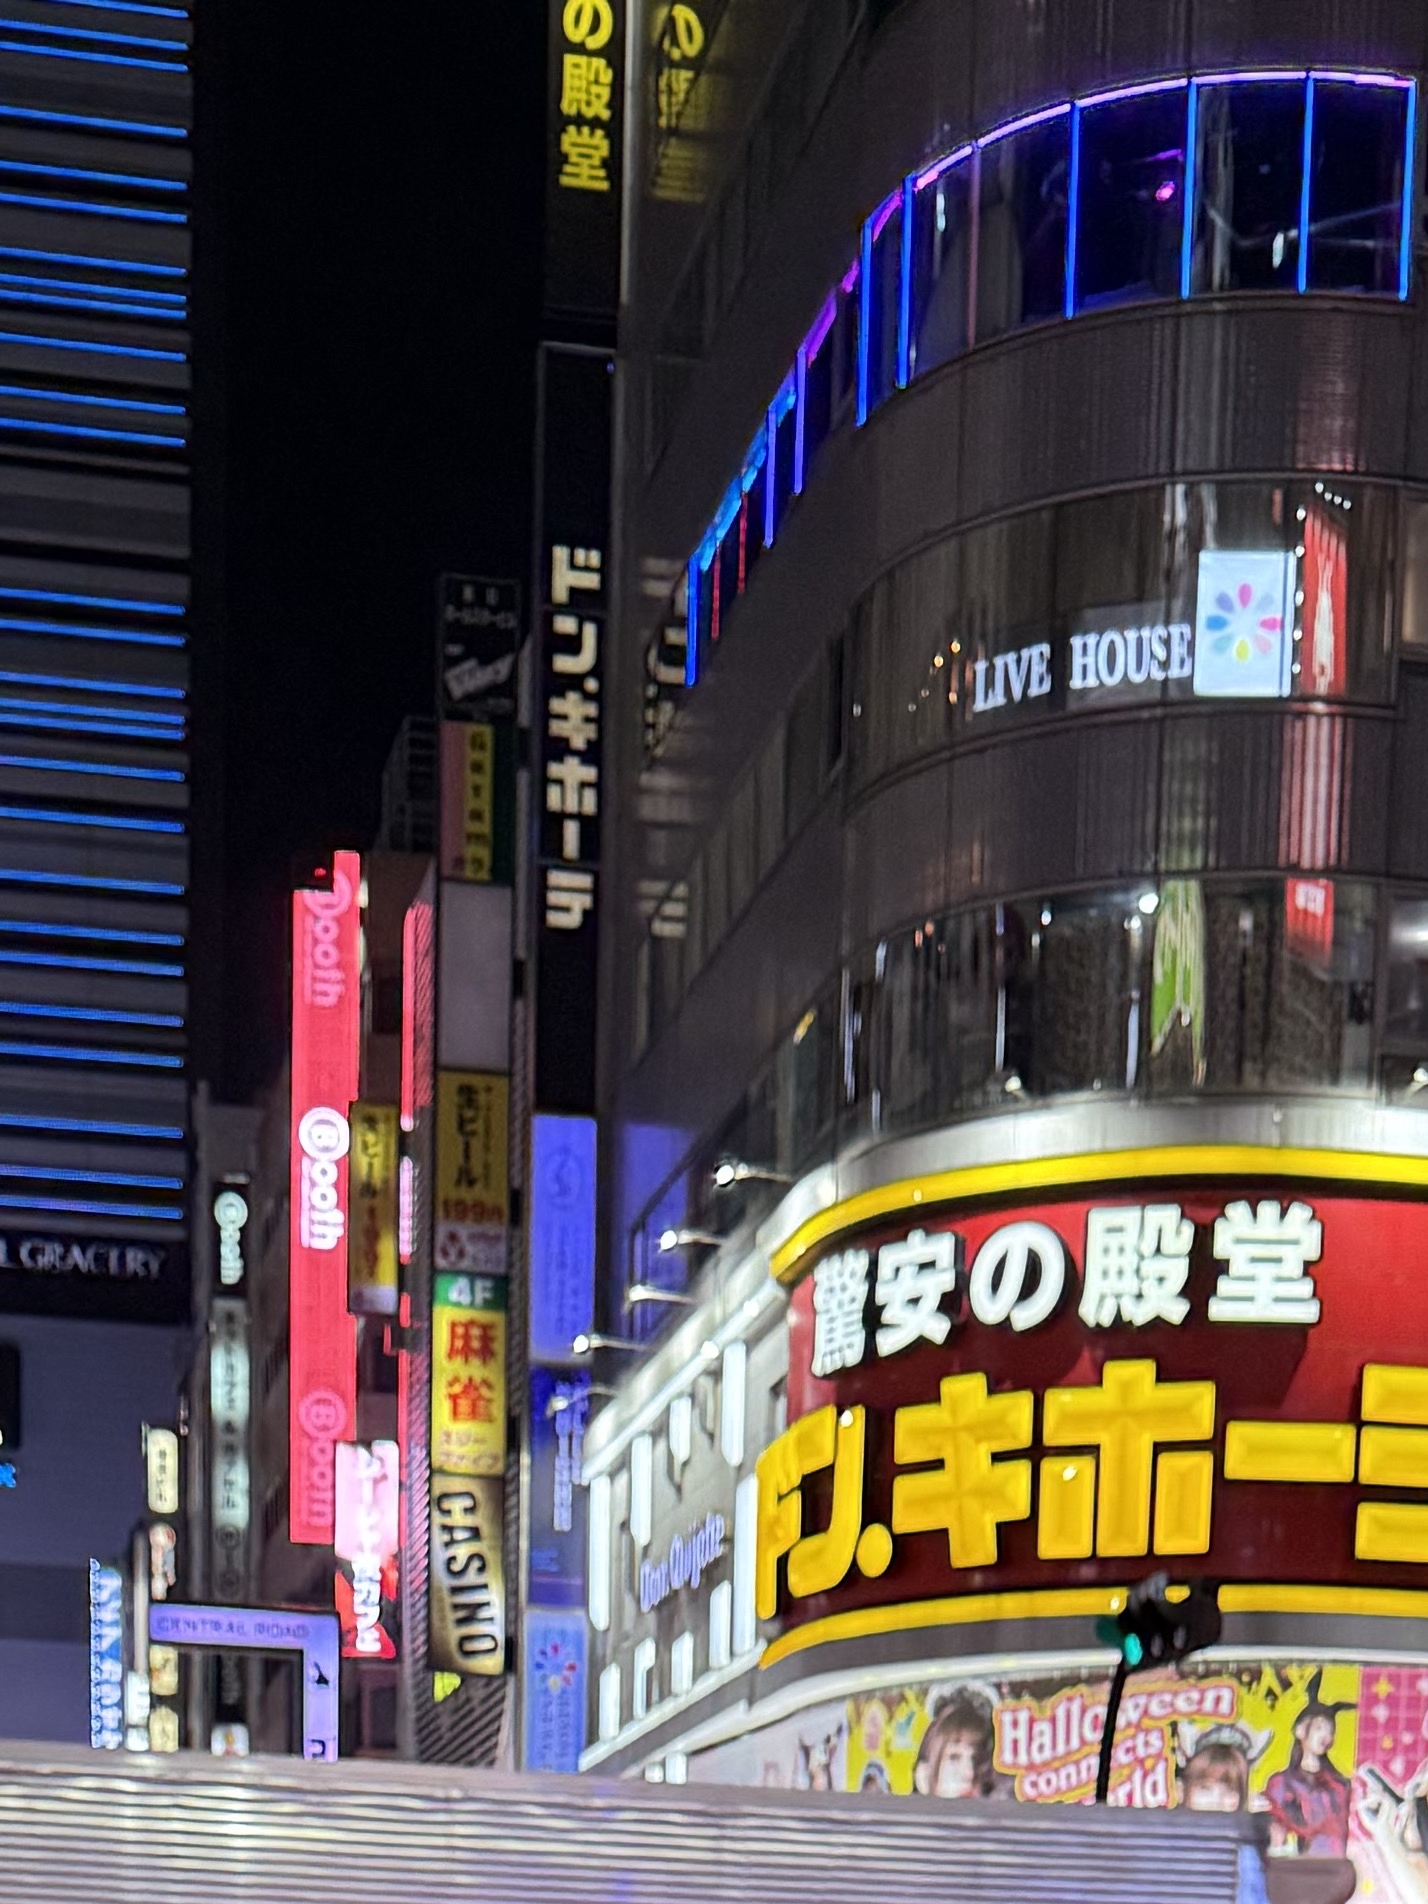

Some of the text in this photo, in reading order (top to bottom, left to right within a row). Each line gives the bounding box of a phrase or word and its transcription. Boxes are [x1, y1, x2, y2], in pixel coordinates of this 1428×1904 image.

[972, 623, 1192, 713] LIVE HOUSE
[18, 1237, 164, 1281] GRACERY
[447, 1277, 494, 1307] 4F
[811, 1200, 1322, 1377] 驚安の殿堂
[447, 1319, 498, 1424] 麻雀
[436, 1488, 502, 1660] CASINO
[1022, 1727, 1164, 1799] conncts
